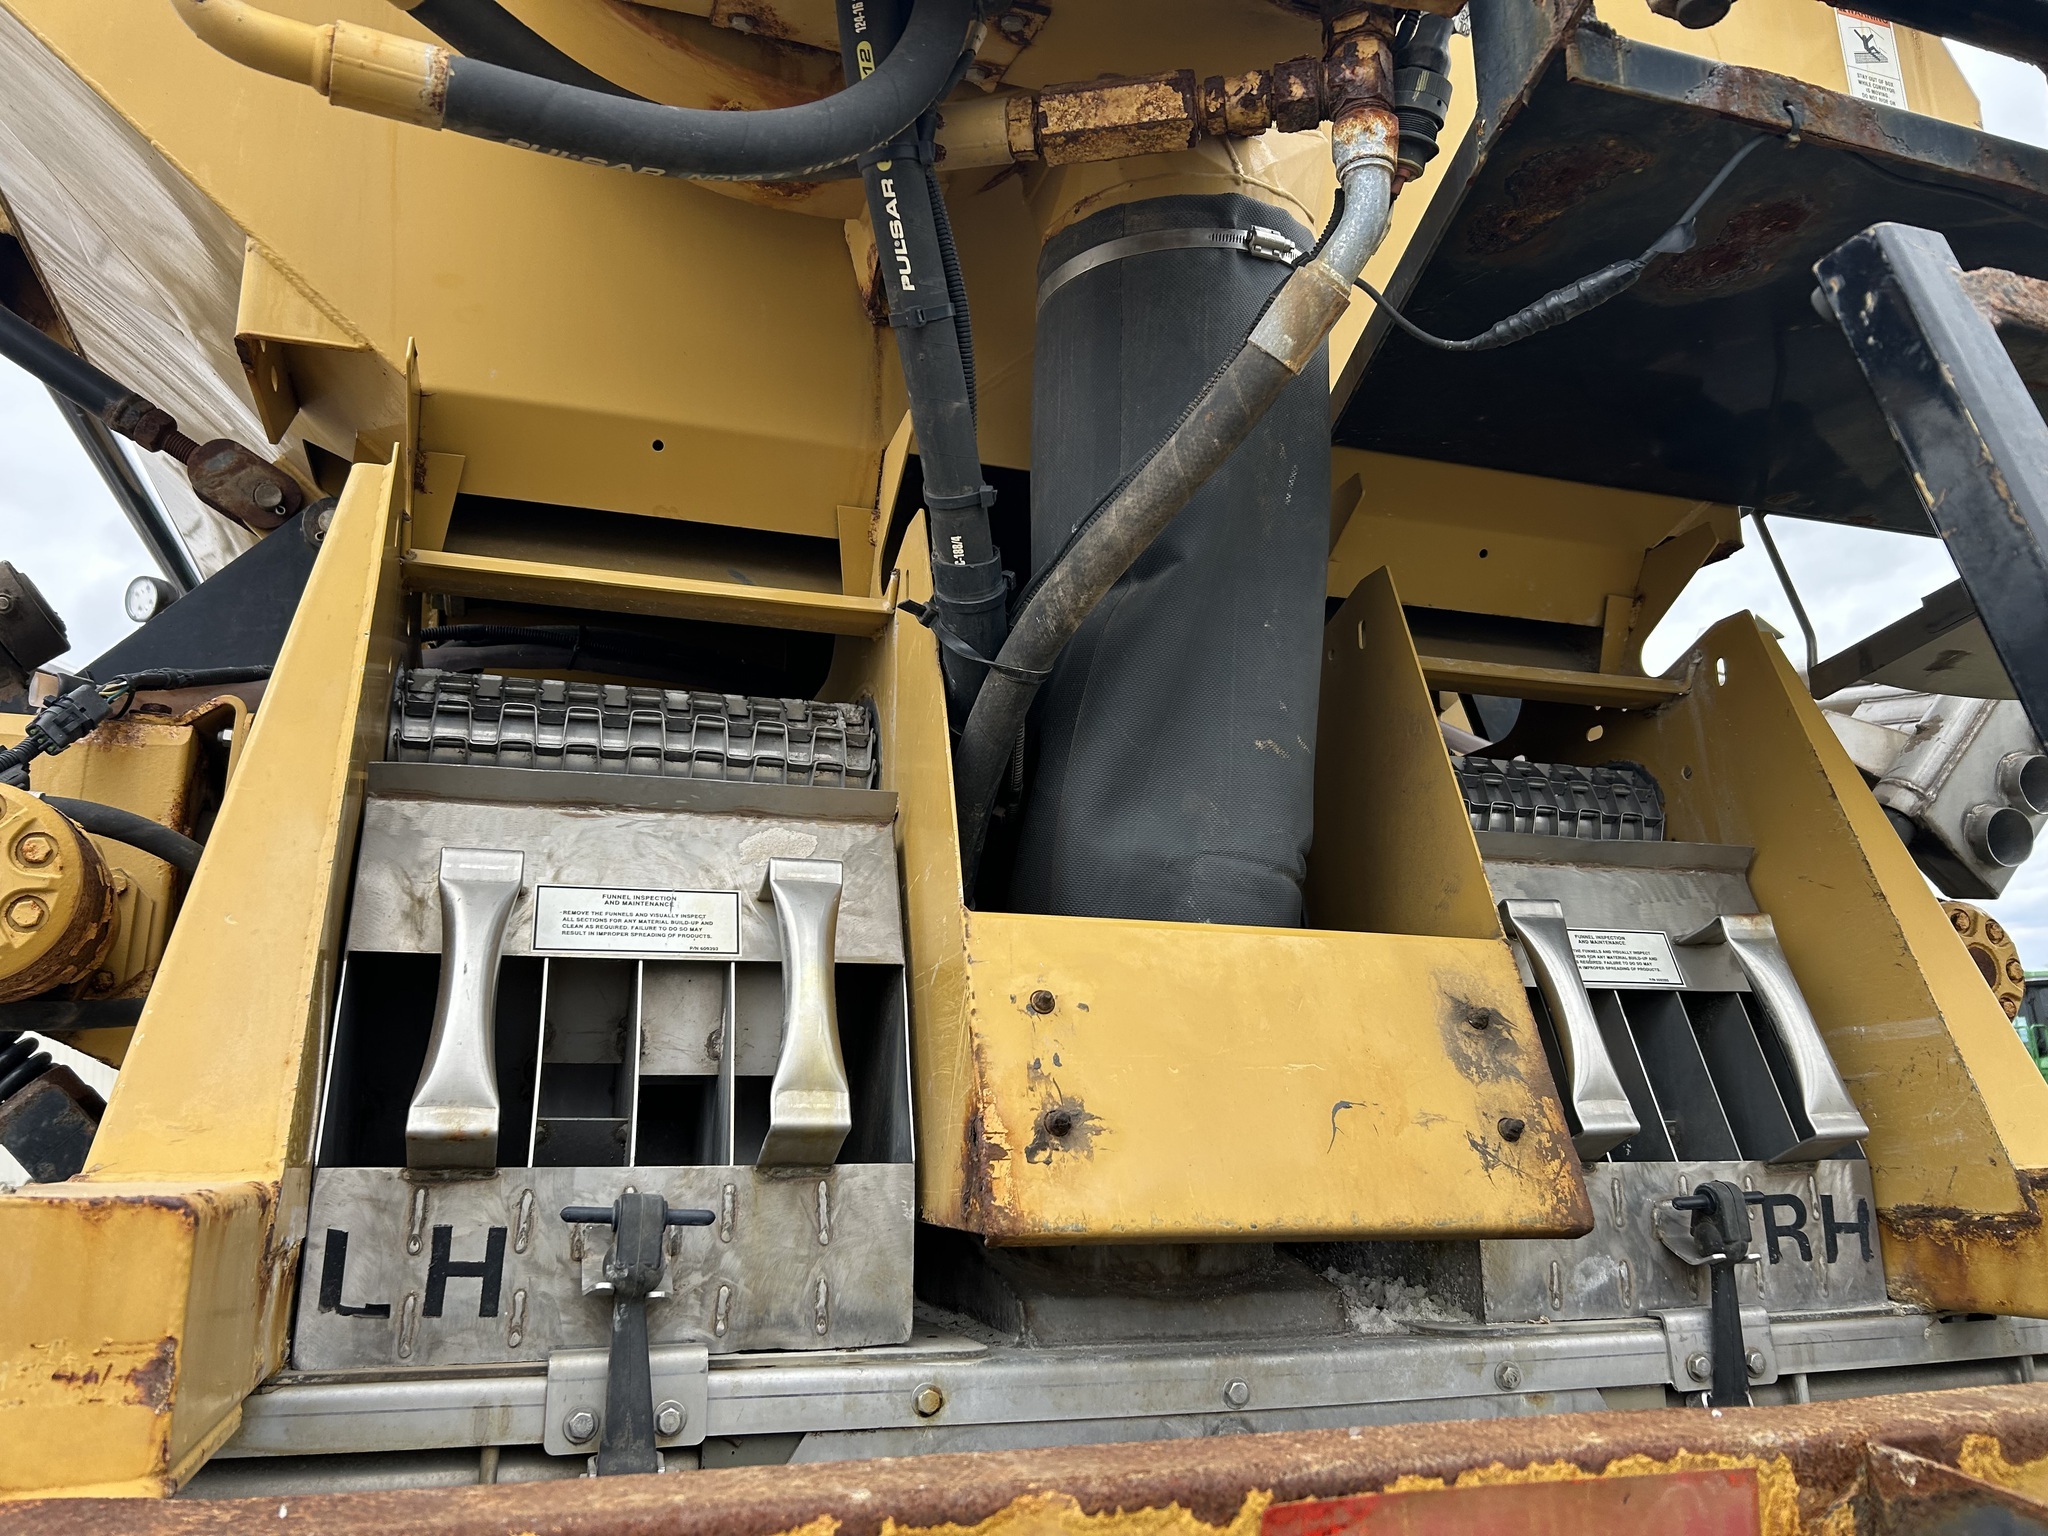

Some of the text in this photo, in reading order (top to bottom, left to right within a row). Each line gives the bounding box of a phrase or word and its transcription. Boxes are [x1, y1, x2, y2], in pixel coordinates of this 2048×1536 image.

[852, 2, 867, 34] 124-16
[1761, 1193, 1874, 1265] RH
[318, 1224, 508, 1319] LH
